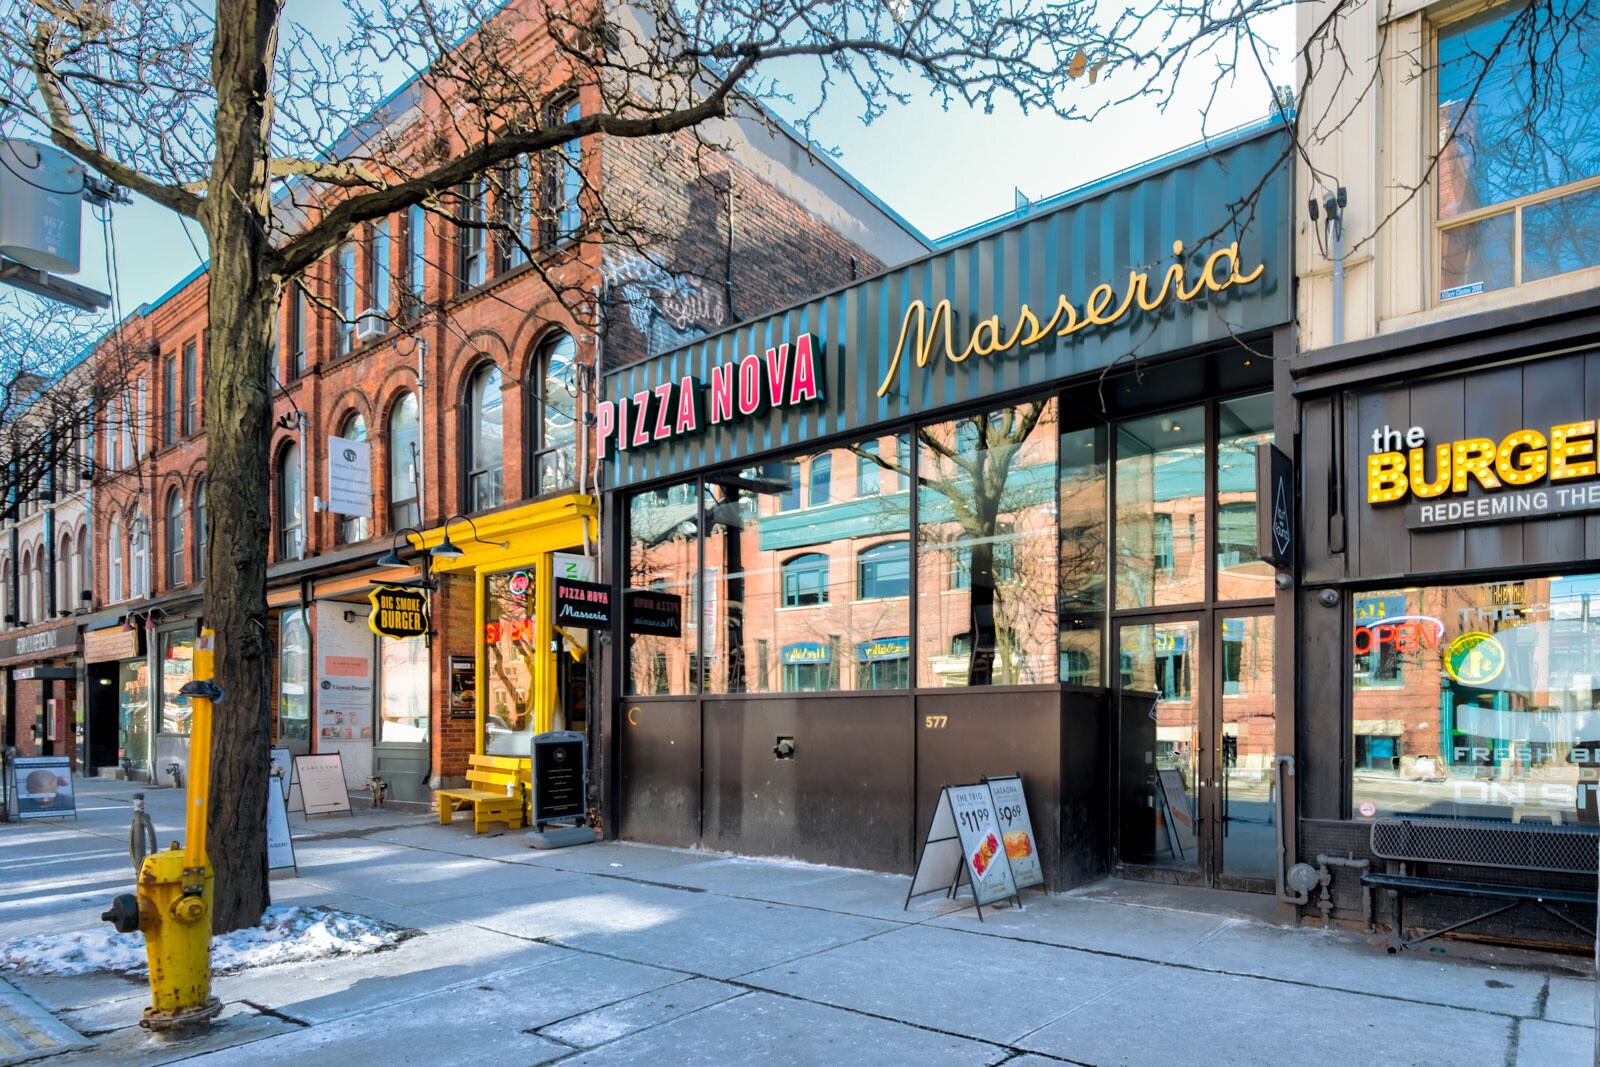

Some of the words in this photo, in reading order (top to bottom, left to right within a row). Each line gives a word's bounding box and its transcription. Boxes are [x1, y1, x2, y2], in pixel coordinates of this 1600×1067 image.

[876, 239, 1264, 397] Masseria
[597, 375, 697, 459] PIZZA
[711, 332, 818, 425] NOVA
[1371, 425, 1425, 453] the
[1367, 418, 1600, 504] BURGE
[1421, 491, 1548, 523] REDEEMING
[1556, 485, 1600, 507] THE
[381, 595, 394, 610] BIG
[395, 596, 421, 612] SMOKE
[559, 585, 586, 600] PIZZA
[587, 590, 609, 604] NOVA
[381, 609, 421, 631] BURGER
[559, 603, 609, 621] Masseria
[1354, 623, 1438, 655] OPEN
[925, 716, 948, 729] 577
[1454, 746, 1557, 762] FRESH
[956, 793, 968, 802] THE
[969, 792, 983, 801] TRIO
[1454, 780, 1526, 807] ON
